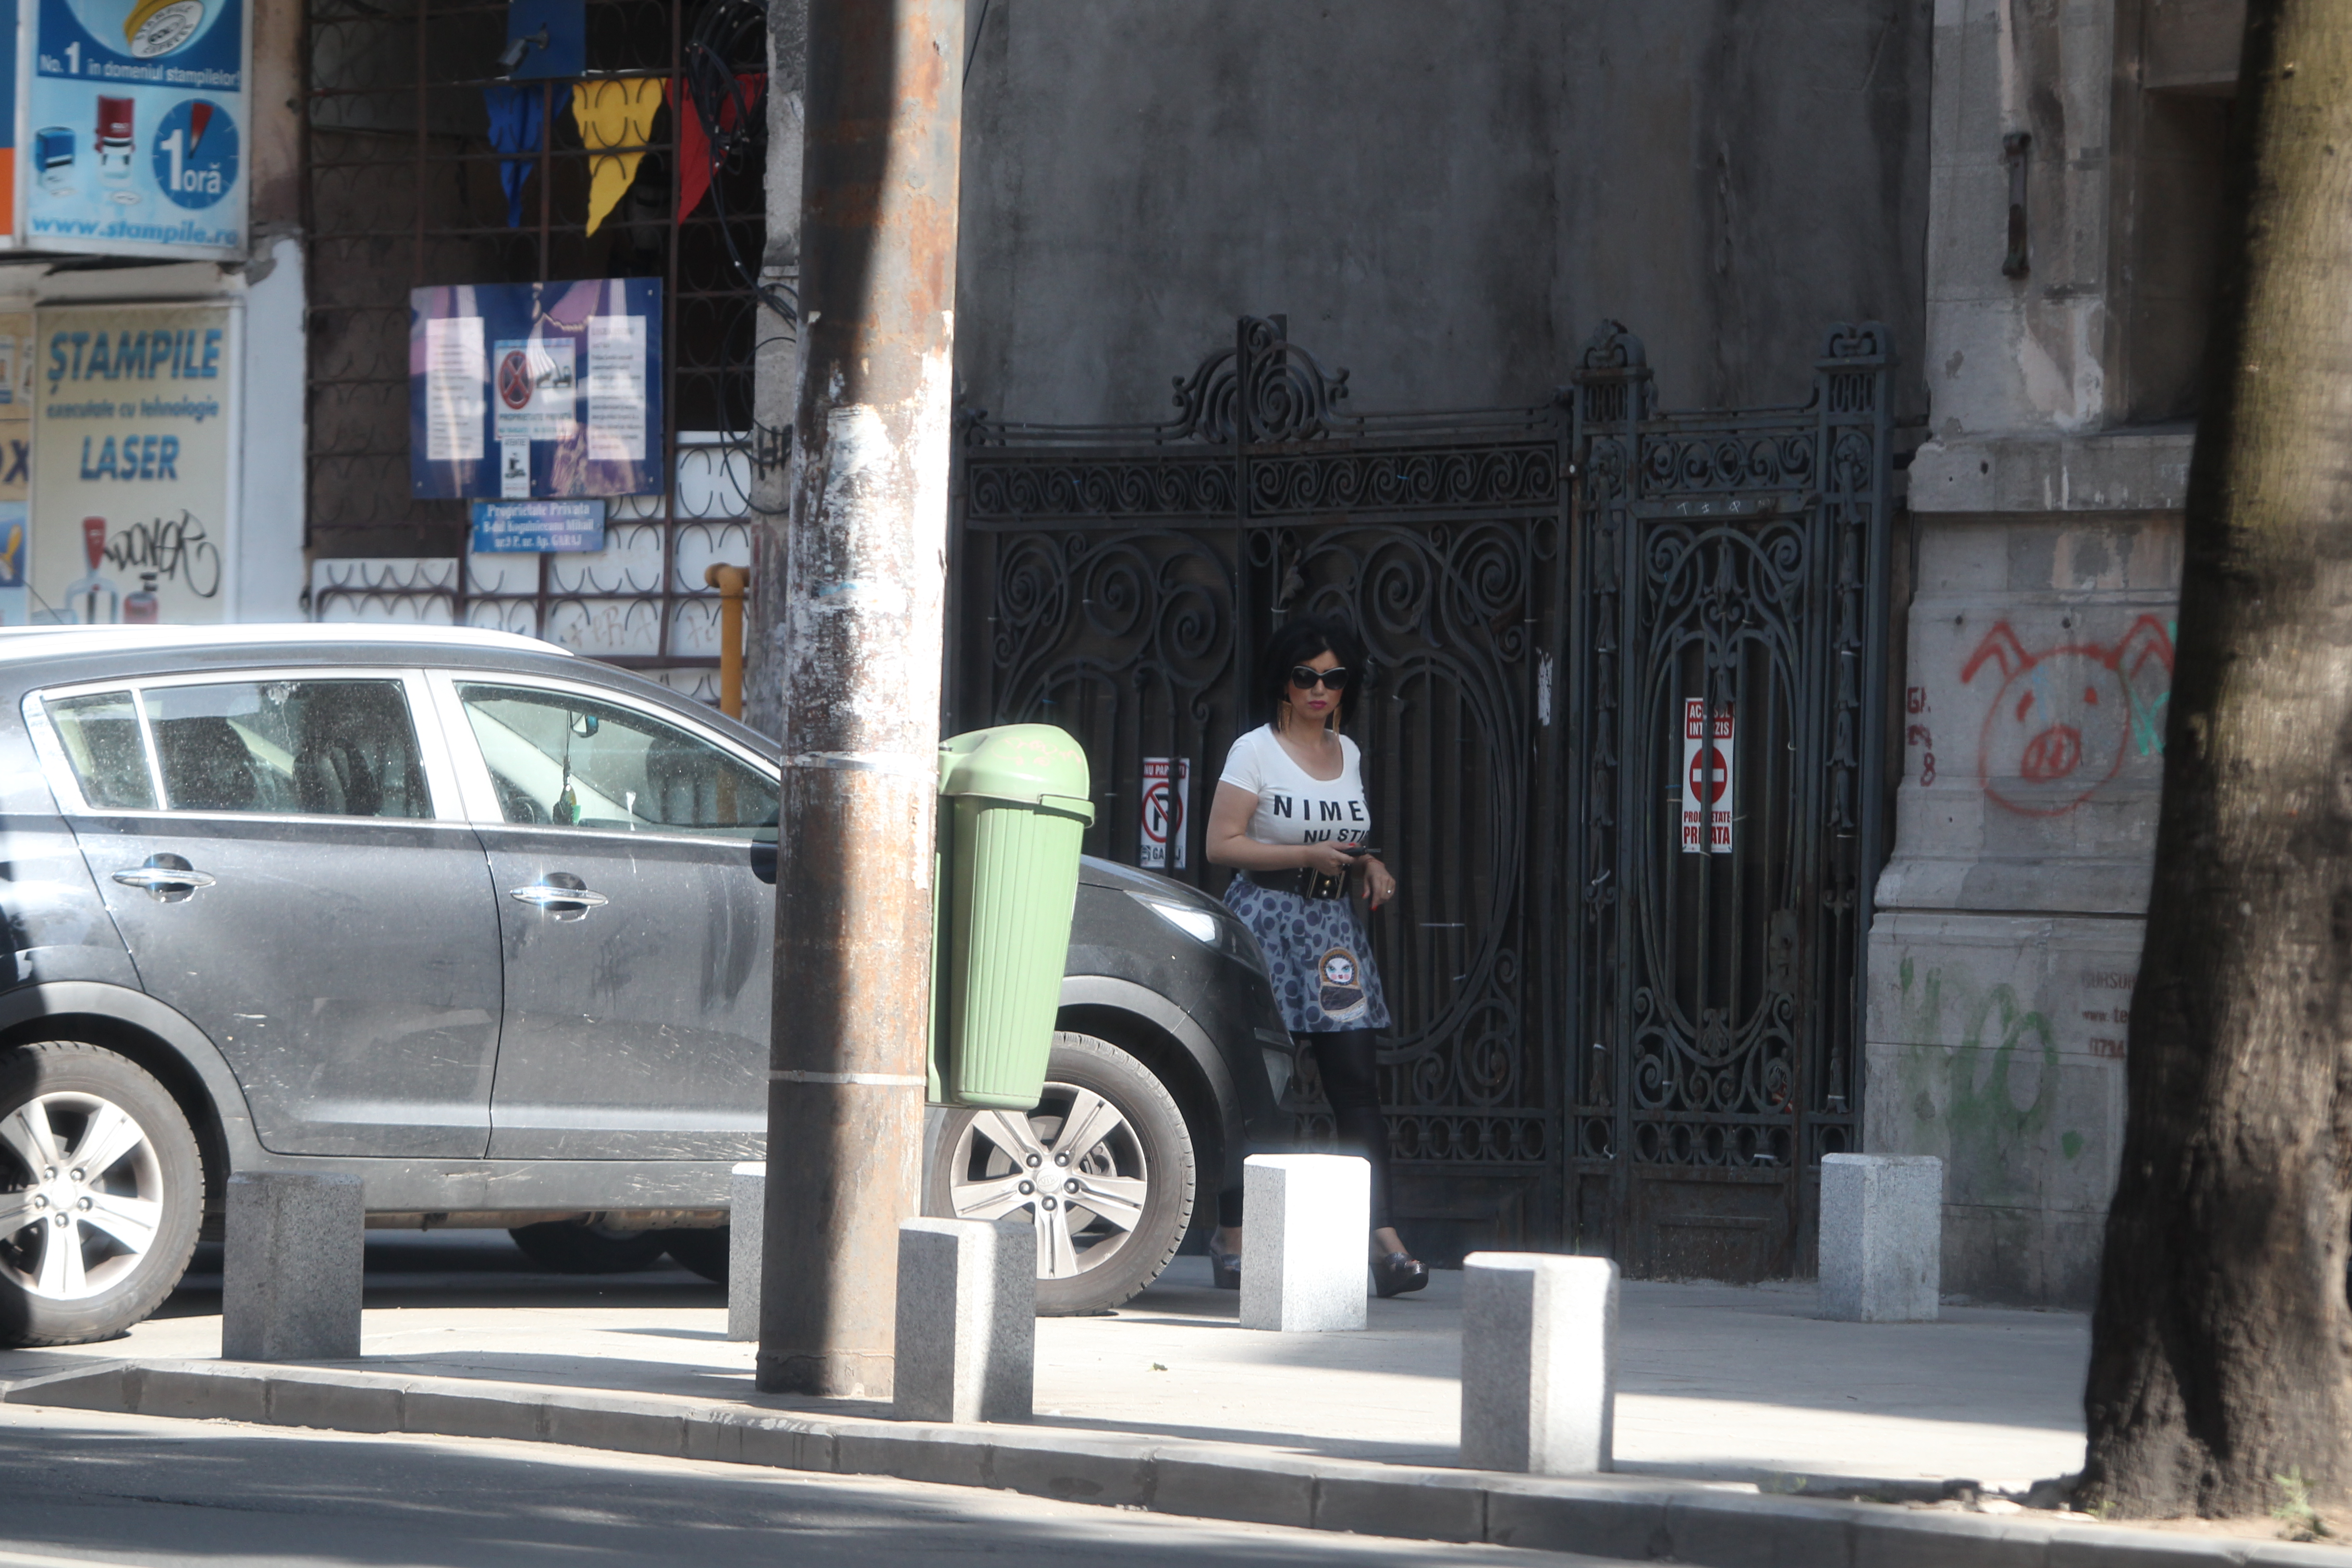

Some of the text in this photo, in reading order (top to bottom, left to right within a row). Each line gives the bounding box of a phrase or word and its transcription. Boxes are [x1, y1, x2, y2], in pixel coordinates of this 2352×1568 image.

[39, 54, 63, 73] No.
[64, 41, 81, 74] 1
[103, 61, 163, 81] domeniul
[160, 128, 221, 192] 1 oră
[33, 217, 237, 246] www.stampile.ro
[119, 402, 135, 417] cu
[141, 395, 219, 423] tehnologie
[81, 435, 180, 479] LASER
[487, 503, 549, 519] Proprietate
[551, 534, 582, 546] GARAJ
[1690, 722, 1729, 735] INTZIS
[1144, 764, 1154, 775] NU
[1274, 795, 1369, 821] NIME
[1304, 829, 1331, 843] NU
[1153, 847, 1181, 860] GAJ
